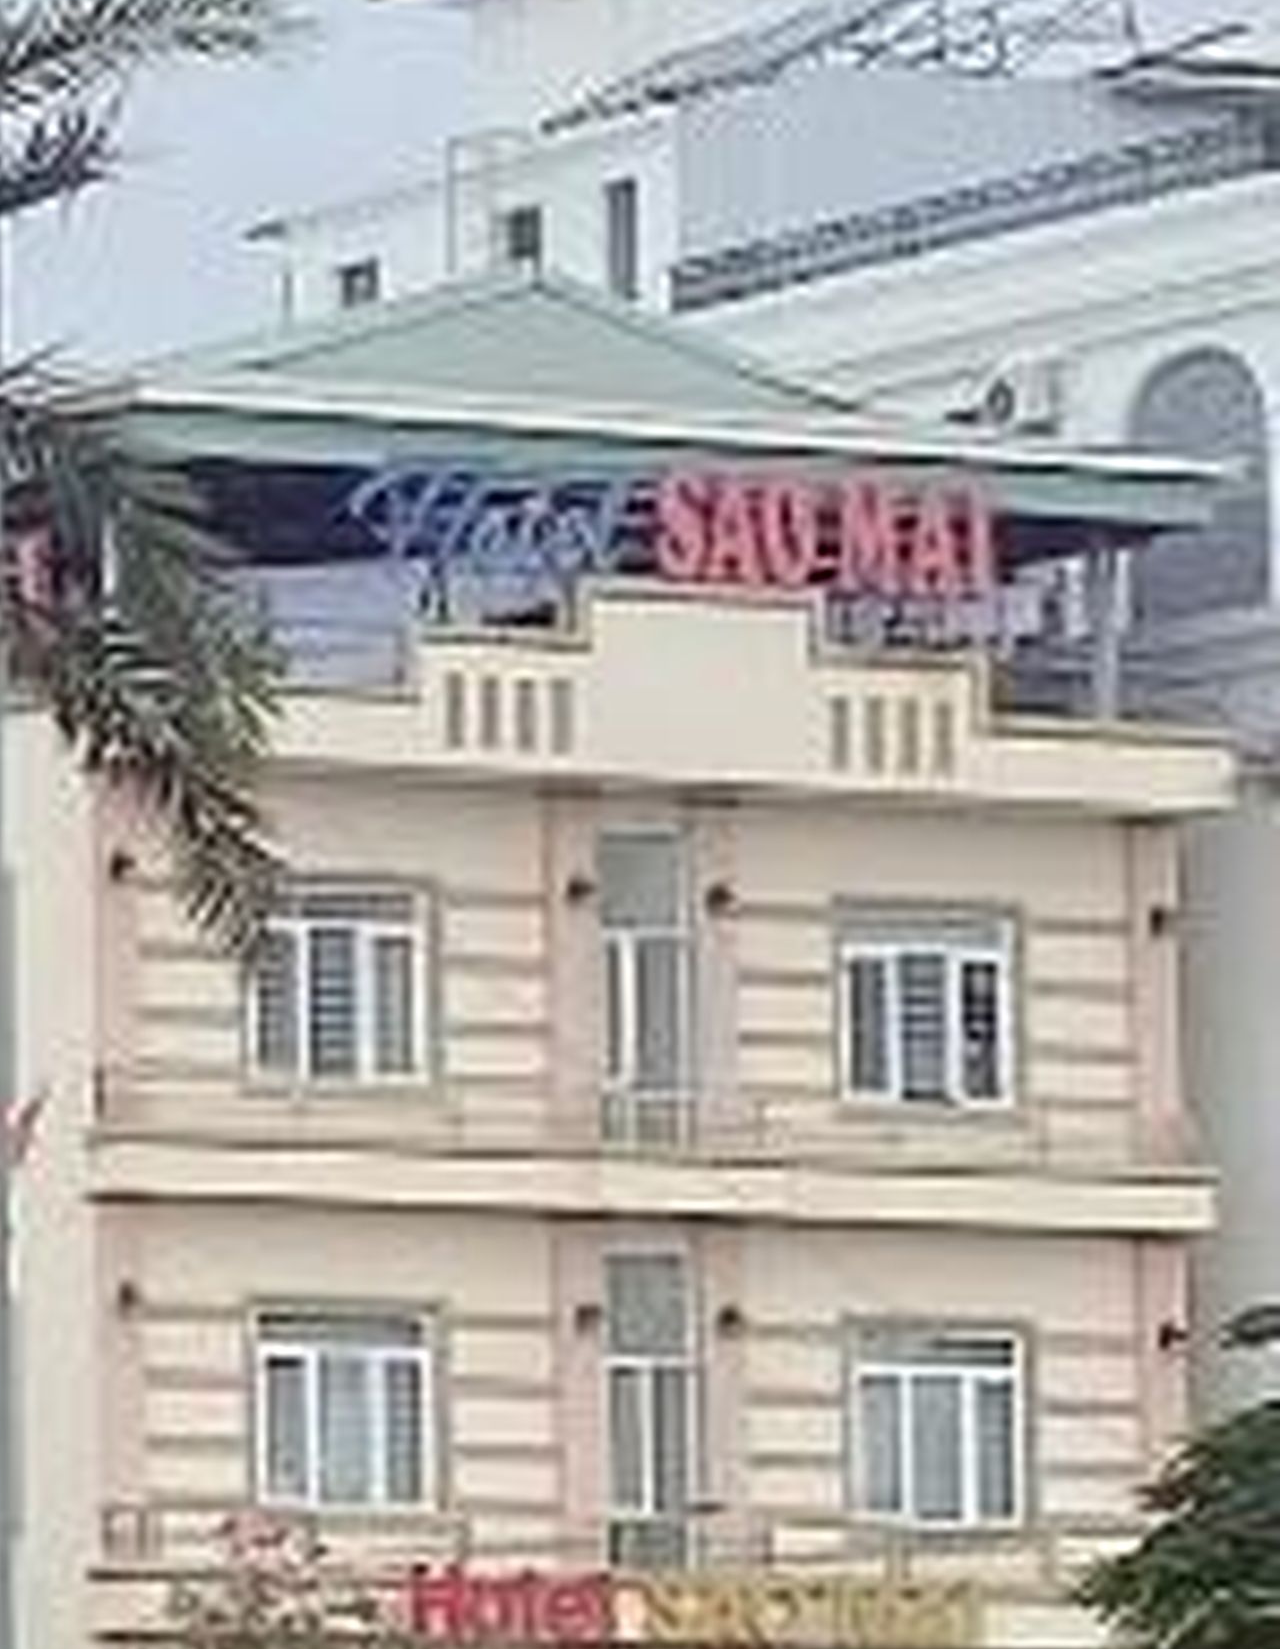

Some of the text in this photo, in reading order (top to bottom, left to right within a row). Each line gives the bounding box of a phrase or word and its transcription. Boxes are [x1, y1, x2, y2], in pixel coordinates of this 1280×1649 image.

[656, 473, 818, 585] SAO
[840, 477, 992, 597] MAI
[410, 1559, 612, 1641] Hotel
